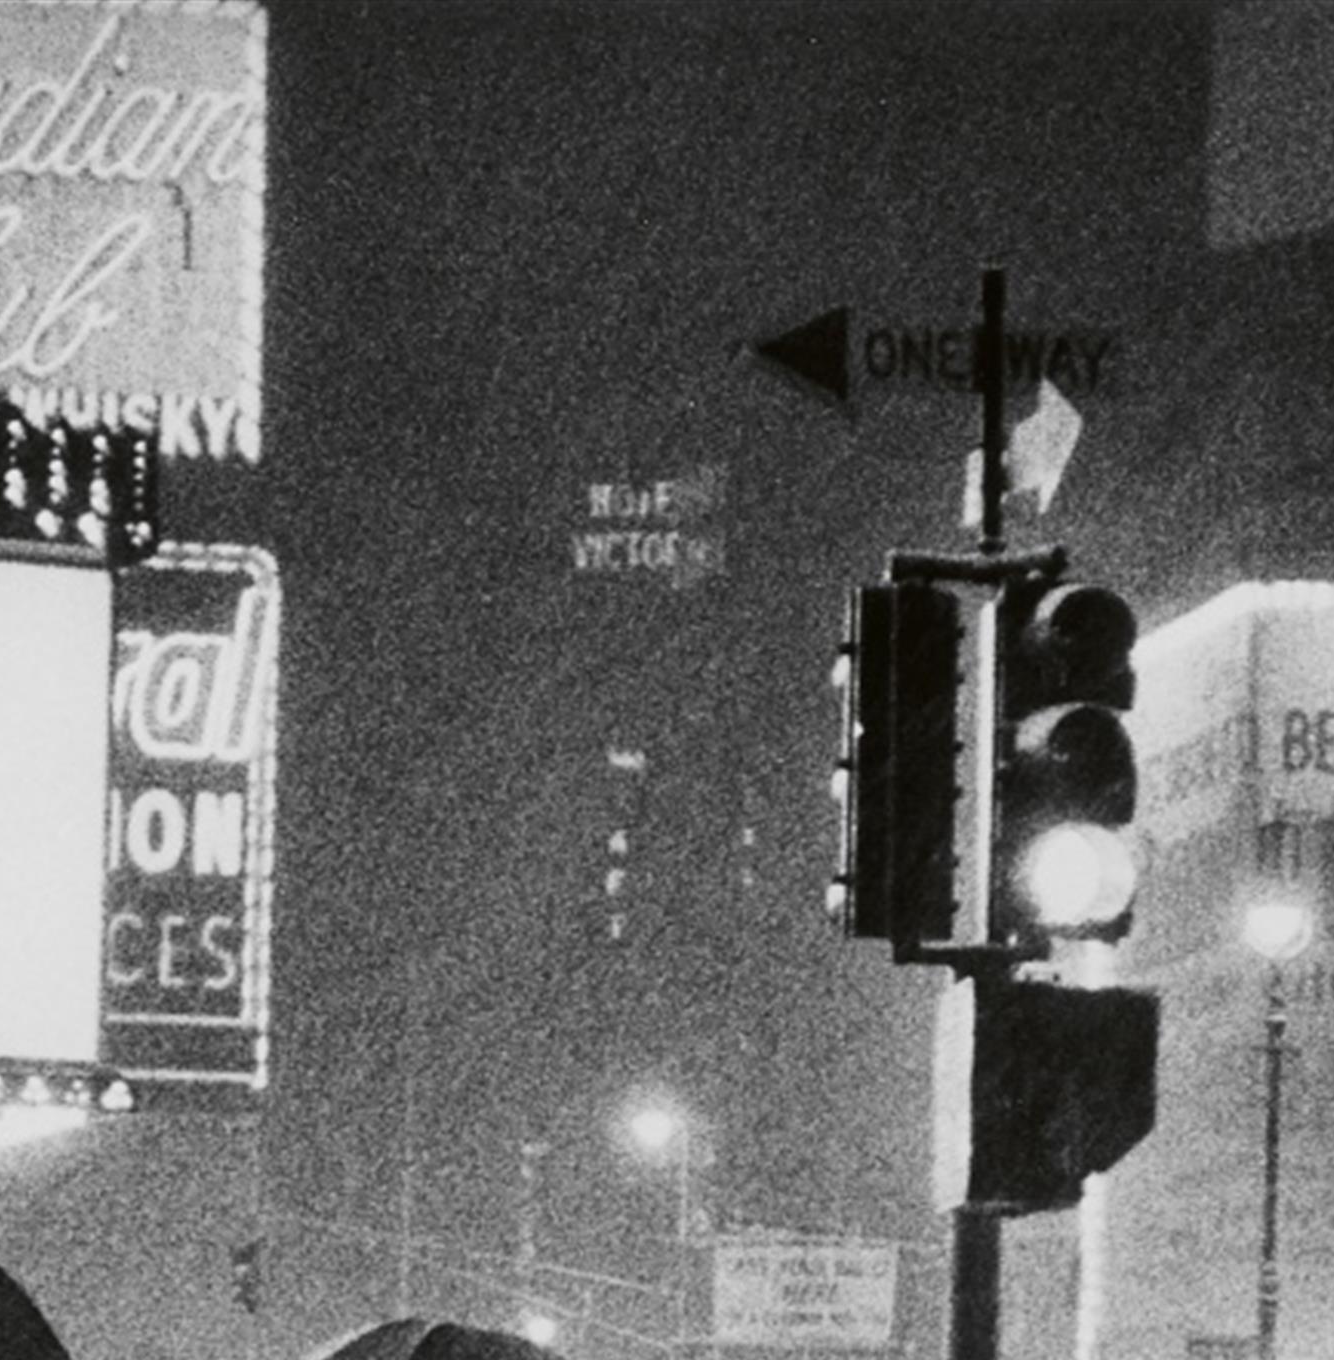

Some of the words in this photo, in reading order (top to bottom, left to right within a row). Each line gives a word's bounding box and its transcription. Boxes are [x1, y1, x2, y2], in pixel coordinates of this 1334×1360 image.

[864, 327, 969, 383] ONE
[1005, 328, 1115, 392] WAY
[105, 911, 238, 991] CES
